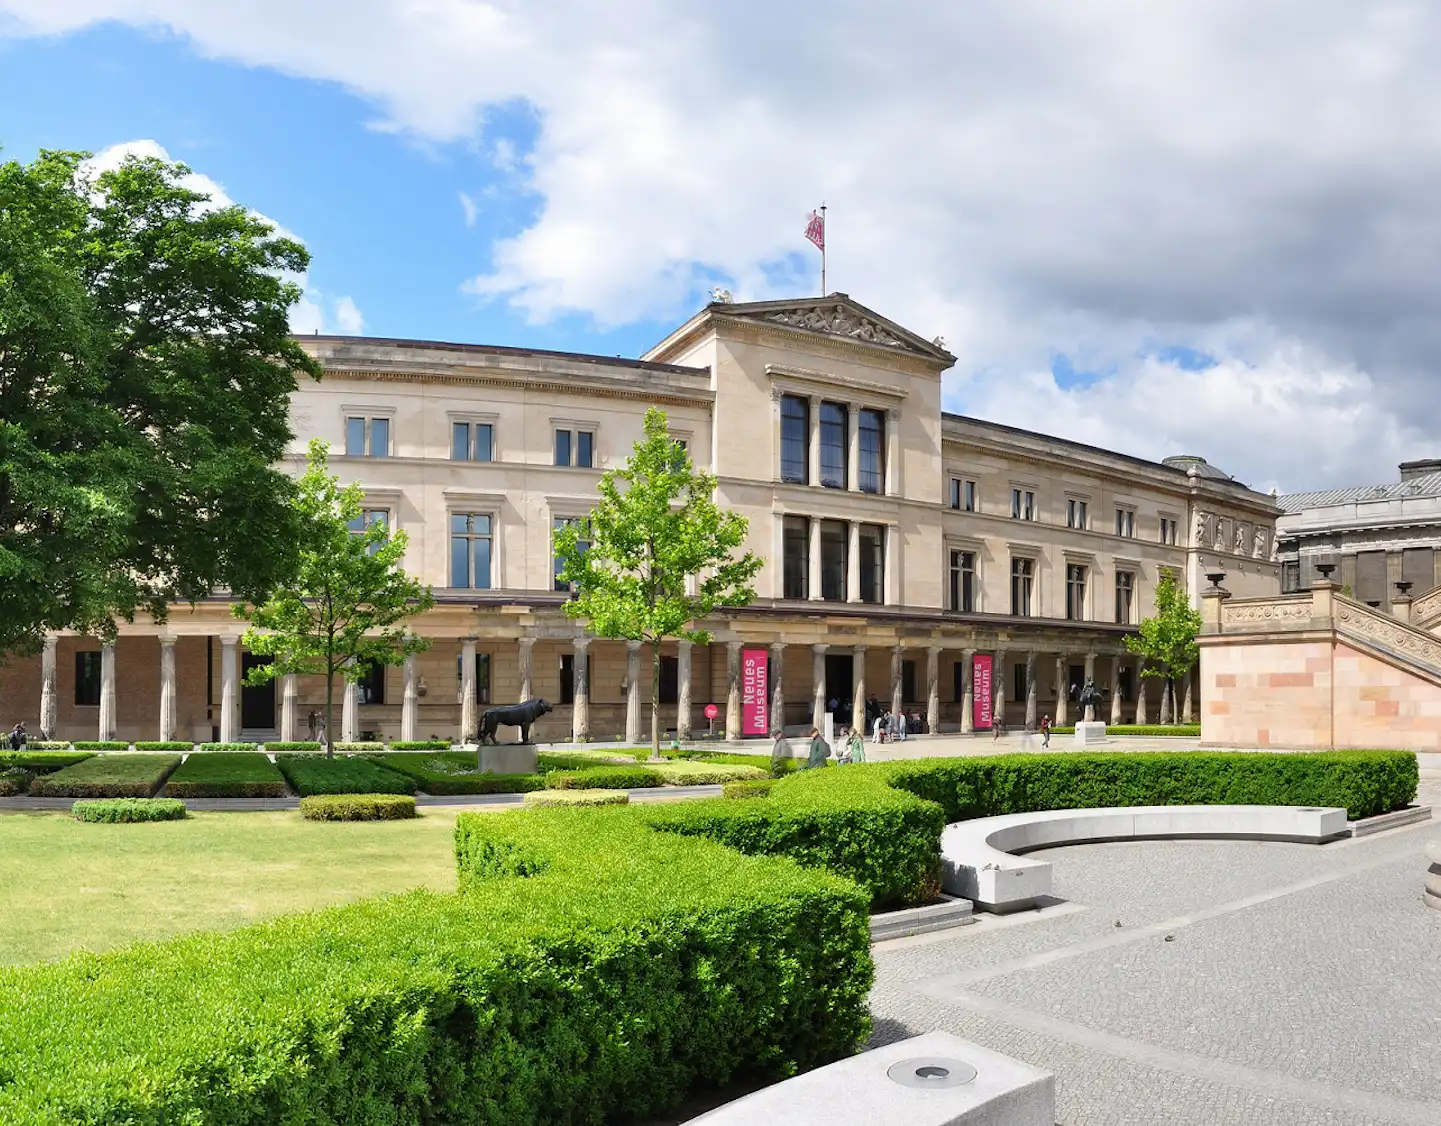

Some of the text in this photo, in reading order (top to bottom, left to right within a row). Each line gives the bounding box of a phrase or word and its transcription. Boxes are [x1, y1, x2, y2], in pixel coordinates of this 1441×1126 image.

[744, 660, 755, 704] Neues
[754, 666, 765, 728] Museum
[981, 669, 989, 722] Museum
